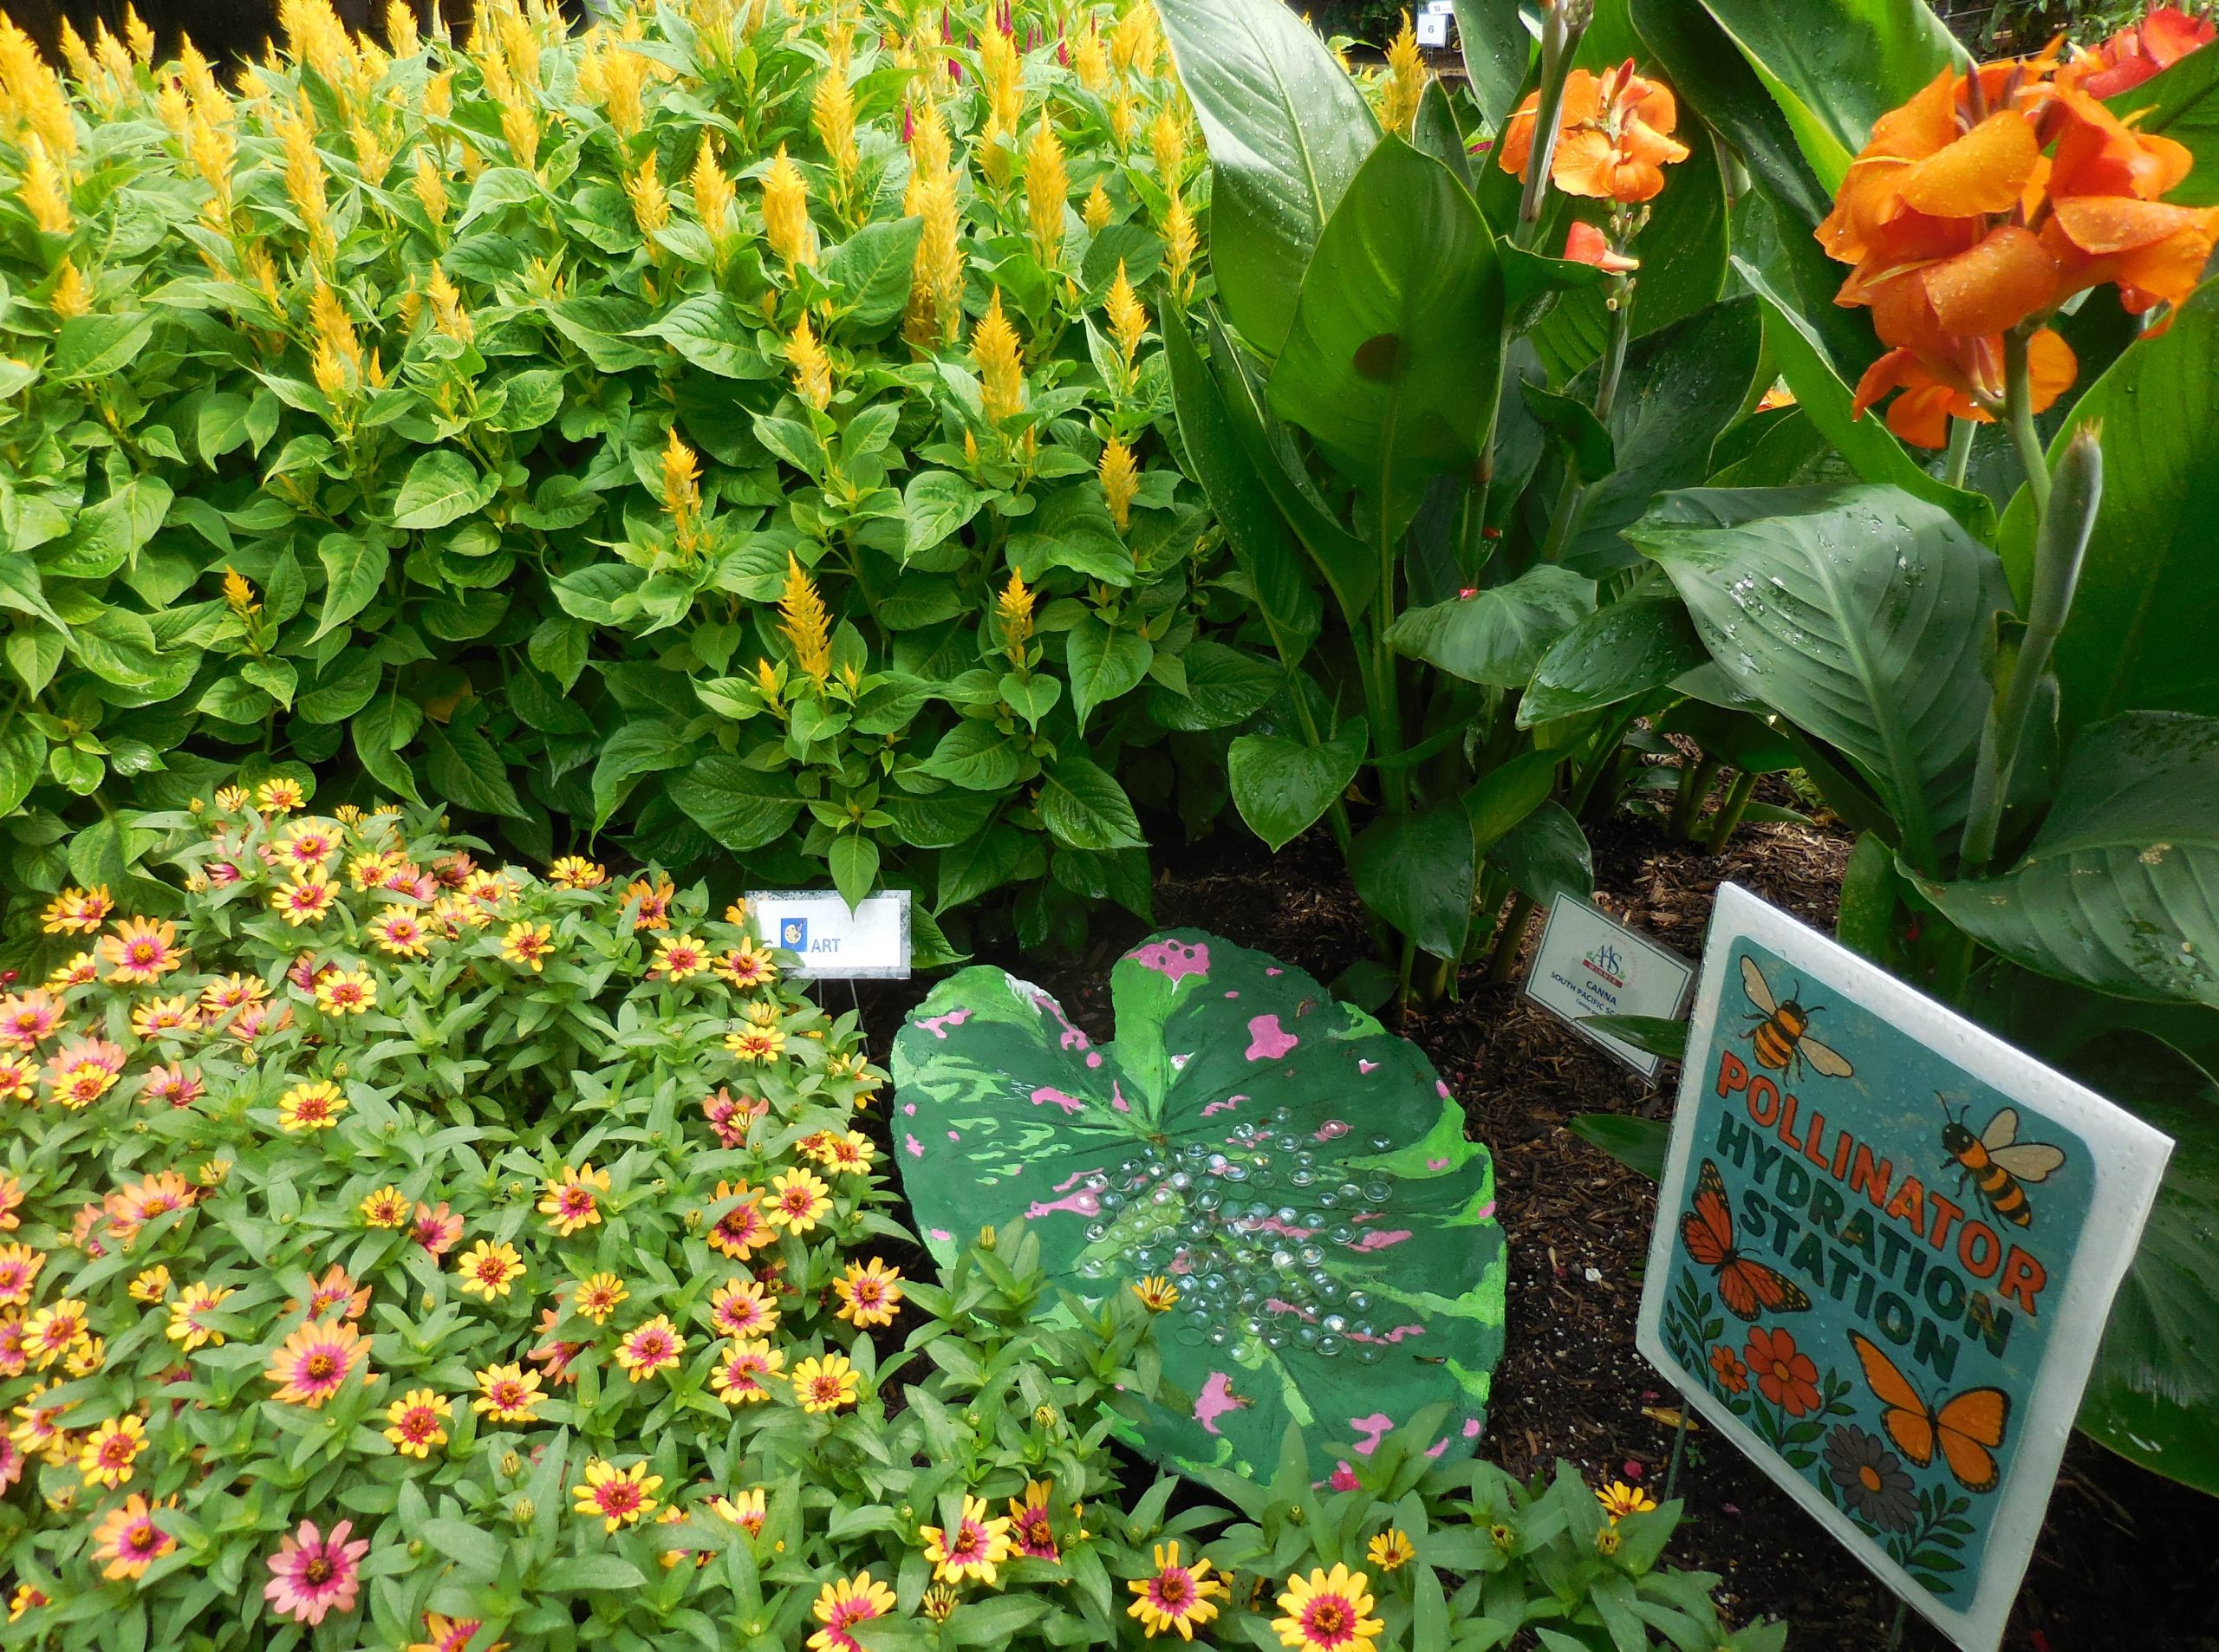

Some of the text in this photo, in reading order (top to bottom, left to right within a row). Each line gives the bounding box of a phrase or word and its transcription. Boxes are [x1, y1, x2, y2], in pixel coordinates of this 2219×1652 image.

[811, 938, 841, 953] ART
[1592, 945, 1622, 975] AAS
[1550, 971, 1605, 1011] SOUTH PACIFIC
[1585, 980, 1617, 1006] CANNA
[1715, 1050, 2049, 1318] POLLINATOR
[1715, 1113, 2014, 1360] HYDRATION
[1739, 1190, 1962, 1383] STATION
